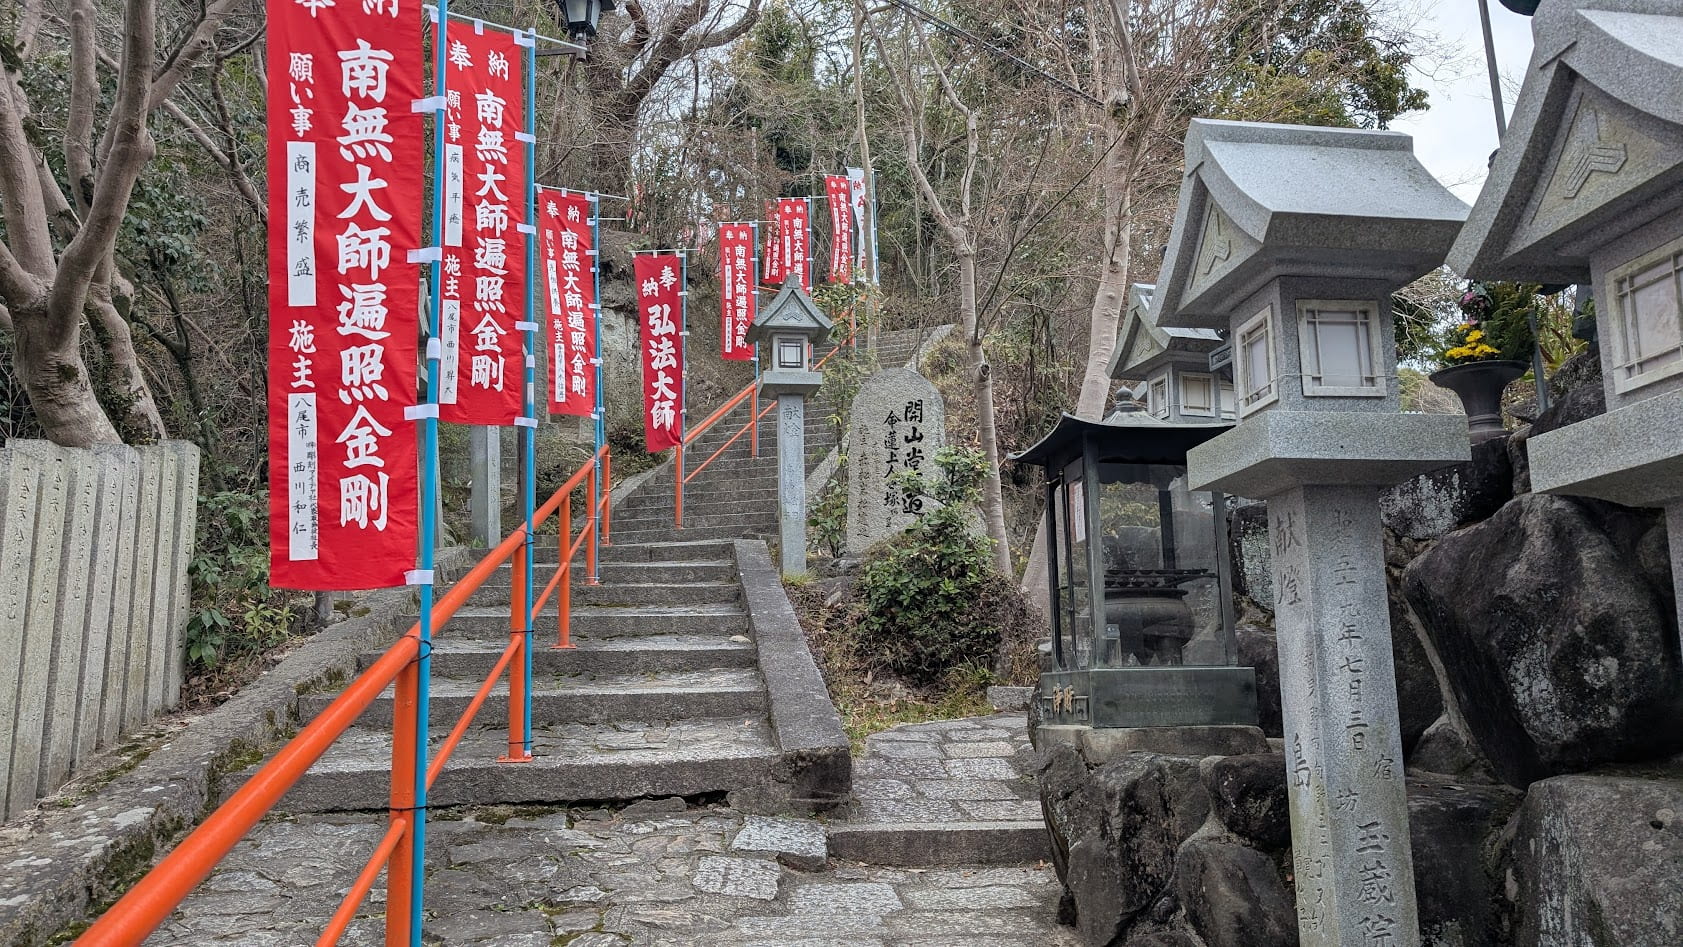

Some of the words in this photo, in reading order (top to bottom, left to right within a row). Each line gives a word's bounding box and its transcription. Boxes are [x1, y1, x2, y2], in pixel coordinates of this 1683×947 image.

[289, 52, 314, 137] 願い事
[449, 40, 509, 81] 奉納
[447, 89, 461, 142] 願い事
[293, 154, 313, 278] 商売繁盛
[471, 88, 509, 392] 南無大師遍照金剛
[546, 200, 580, 223] 奉納
[725, 229, 748, 241] 奉納
[335, 38, 394, 531] 南無大師遍照金剛
[444, 254, 461, 298] 施主
[642, 265, 677, 298] 奉納
[734, 244, 748, 349] 南無大師遍照金剛
[553, 318, 564, 343] 施主
[560, 228, 586, 397] 南無大師遍照金剛
[289, 319, 316, 388] 施主
[648, 303, 677, 431] 弘法大師
[295, 398, 312, 440] 八尾市
[292, 462, 307, 534] 西川和仁
[1355, 821, 1396, 947] 玉蔵院
